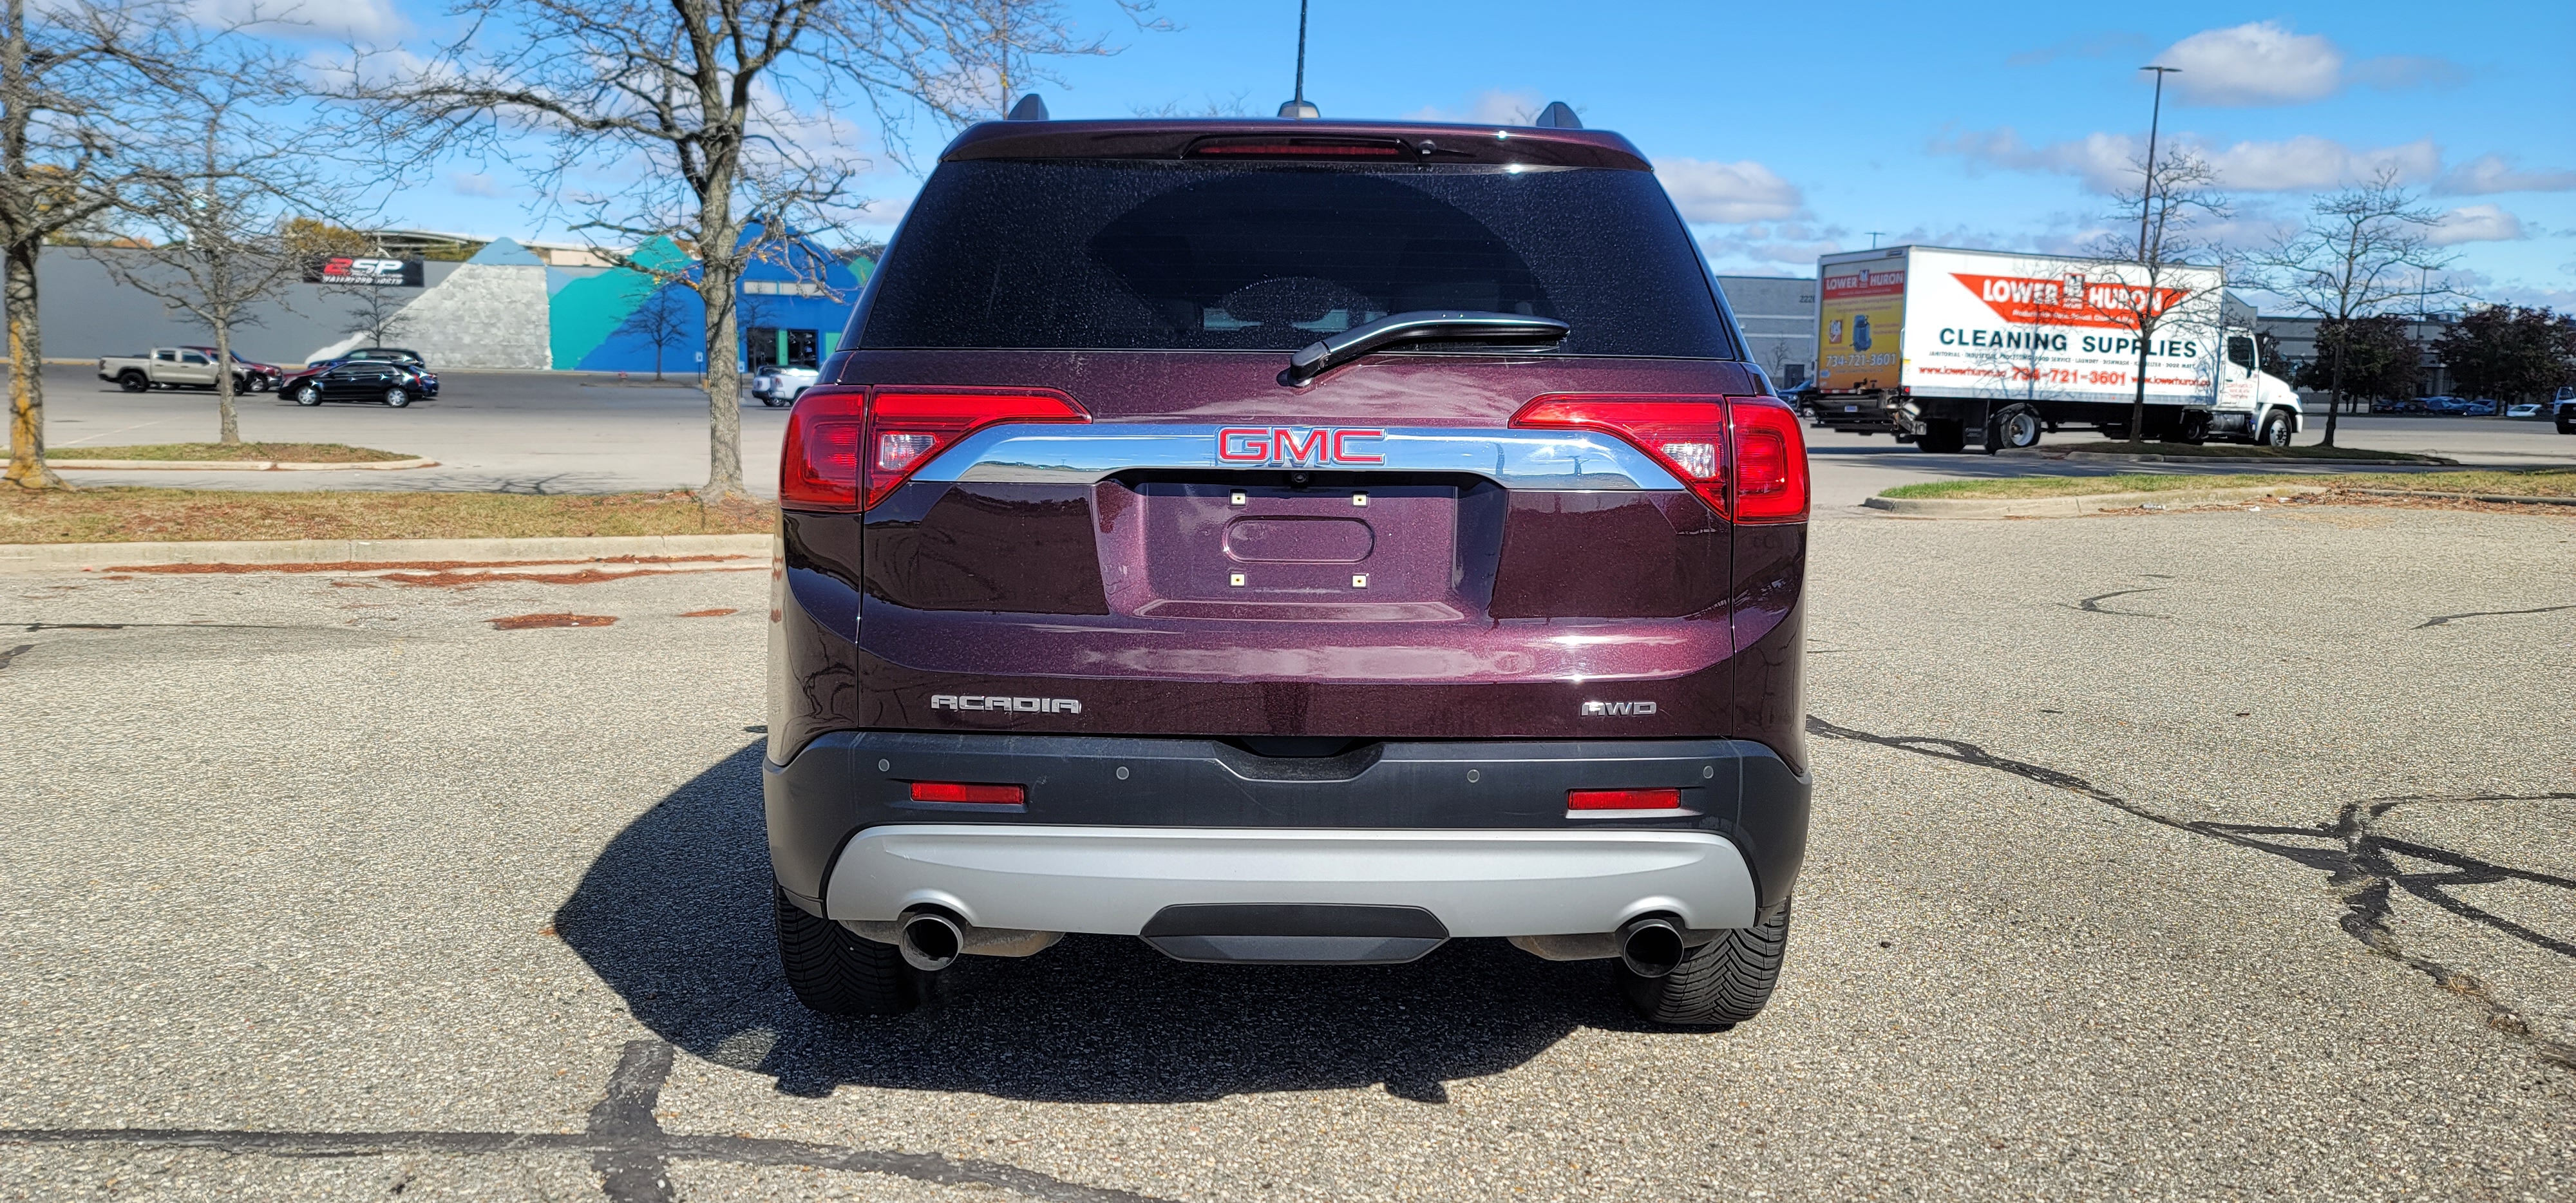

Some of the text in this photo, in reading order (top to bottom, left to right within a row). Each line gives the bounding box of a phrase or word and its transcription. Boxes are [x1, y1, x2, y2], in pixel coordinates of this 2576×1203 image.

[323, 258, 404, 275] 2SP
[1826, 276, 1857, 290] LOWER
[1870, 272, 1904, 287] HURON
[1983, 279, 2059, 306] LOWER
[2088, 287, 2163, 312] HURON
[1939, 328, 2197, 358] CLEANING SUPPLIES
[1826, 353, 1897, 368] 734-721-3601
[2011, 366, 2126, 386] 734-721-3601
[1218, 427, 1385, 465] GMC
[931, 694, 1081, 714] ACADIA
[1581, 701, 1657, 716] AWD
